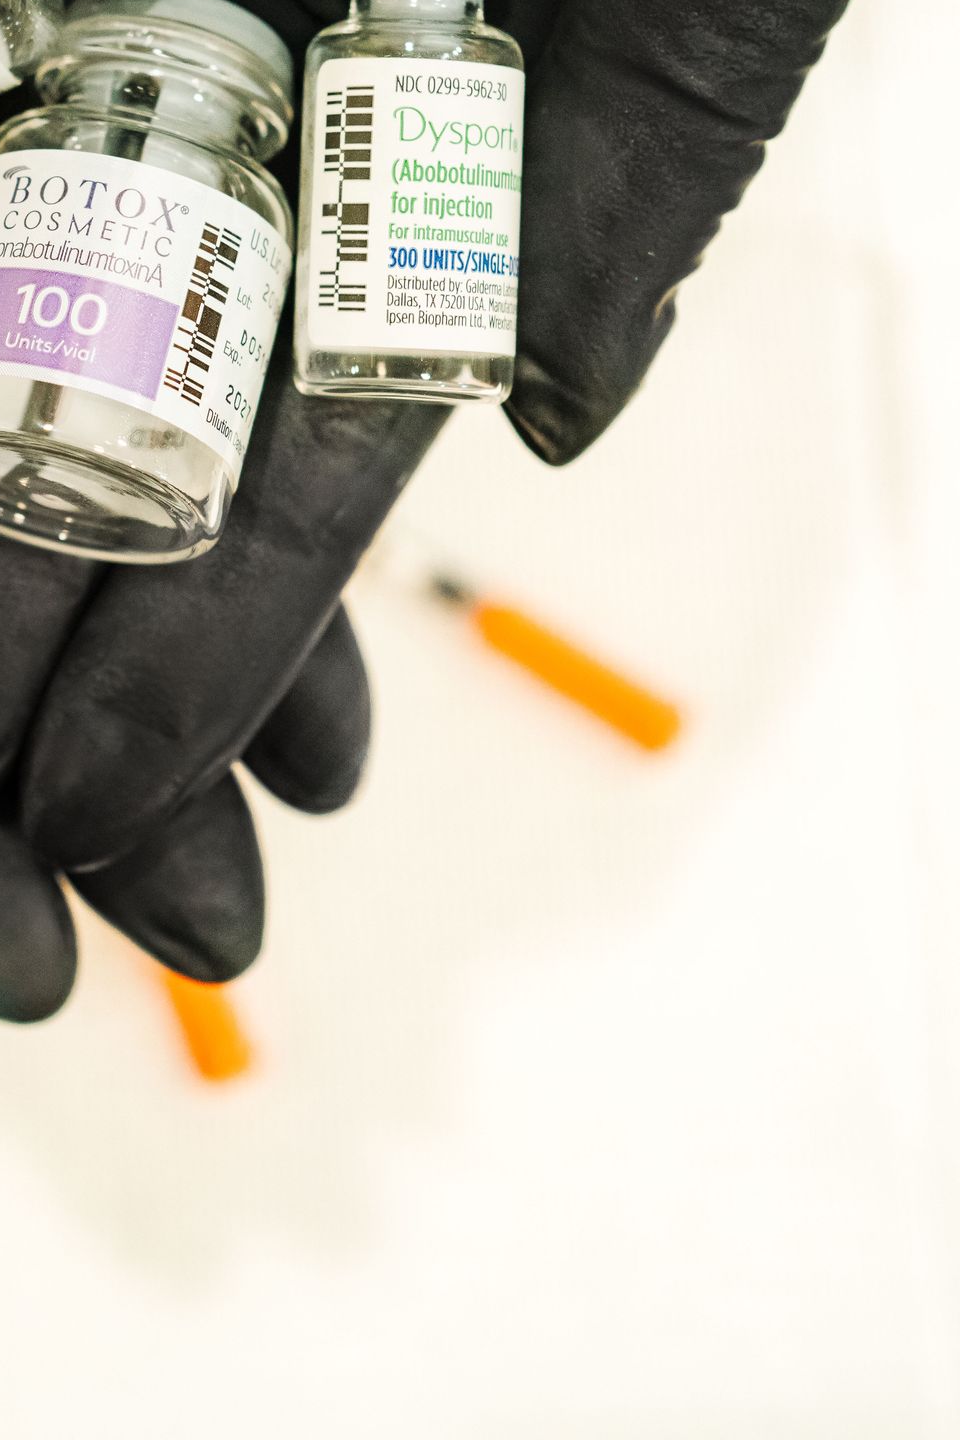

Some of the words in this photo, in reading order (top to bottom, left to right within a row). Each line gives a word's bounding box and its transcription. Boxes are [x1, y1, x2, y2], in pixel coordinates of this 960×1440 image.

[395, 75, 423, 93] NDC
[428, 76, 508, 101] 0299-5962-30
[391, 191, 417, 214] for
[424, 192, 493, 220] injection
[3, 210, 173, 258] COSMETIC
[388, 223, 409, 240] For
[413, 224, 494, 245] intramuscular
[496, 233, 509, 247] use
[388, 247, 418, 268] 300
[387, 275, 446, 292] Distributed
[449, 279, 463, 294] by:
[465, 279, 502, 295] Galderma
[15, 283, 107, 336] 100
[387, 292, 422, 309] Dallas,
[425, 294, 437, 308] TX
[440, 294, 465, 309] 75201
[468, 297, 486, 311] USA.
[386, 309, 415, 326] Ipsen
[418, 310, 467, 328] Biopharm
[4, 331, 96, 364] Units/vial
[206, 408, 233, 440] Dilution
